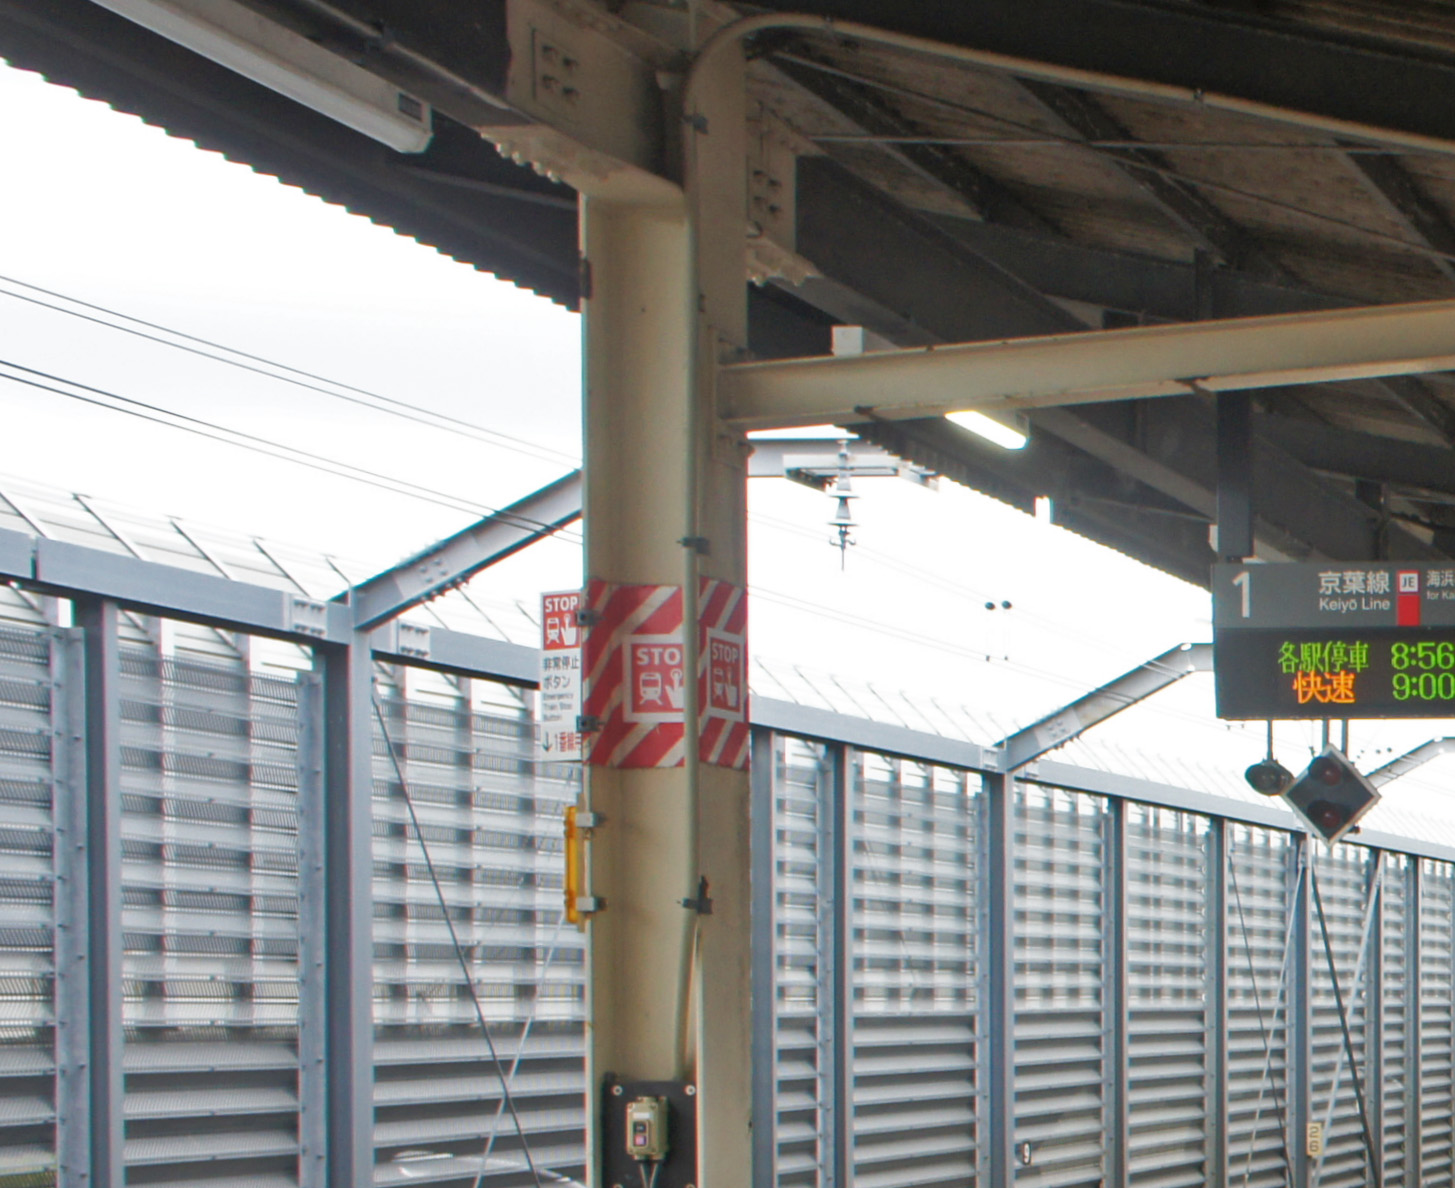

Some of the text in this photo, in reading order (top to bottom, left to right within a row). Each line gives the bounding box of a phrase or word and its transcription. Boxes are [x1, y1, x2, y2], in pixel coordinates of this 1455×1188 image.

[1318, 571, 1390, 595] 京葉線
[1402, 576, 1417, 589] JE
[545, 596, 578, 613] STOP
[1232, 572, 1250, 618] 1
[1361, 598, 1391, 611] Line
[636, 648, 683, 666] STO
[711, 642, 739, 663] STOP
[1278, 641, 1369, 674] 各駅停車
[1391, 641, 1455, 672] 8:56
[543, 674, 571, 690] ボタン
[1293, 672, 1356, 703] 快速
